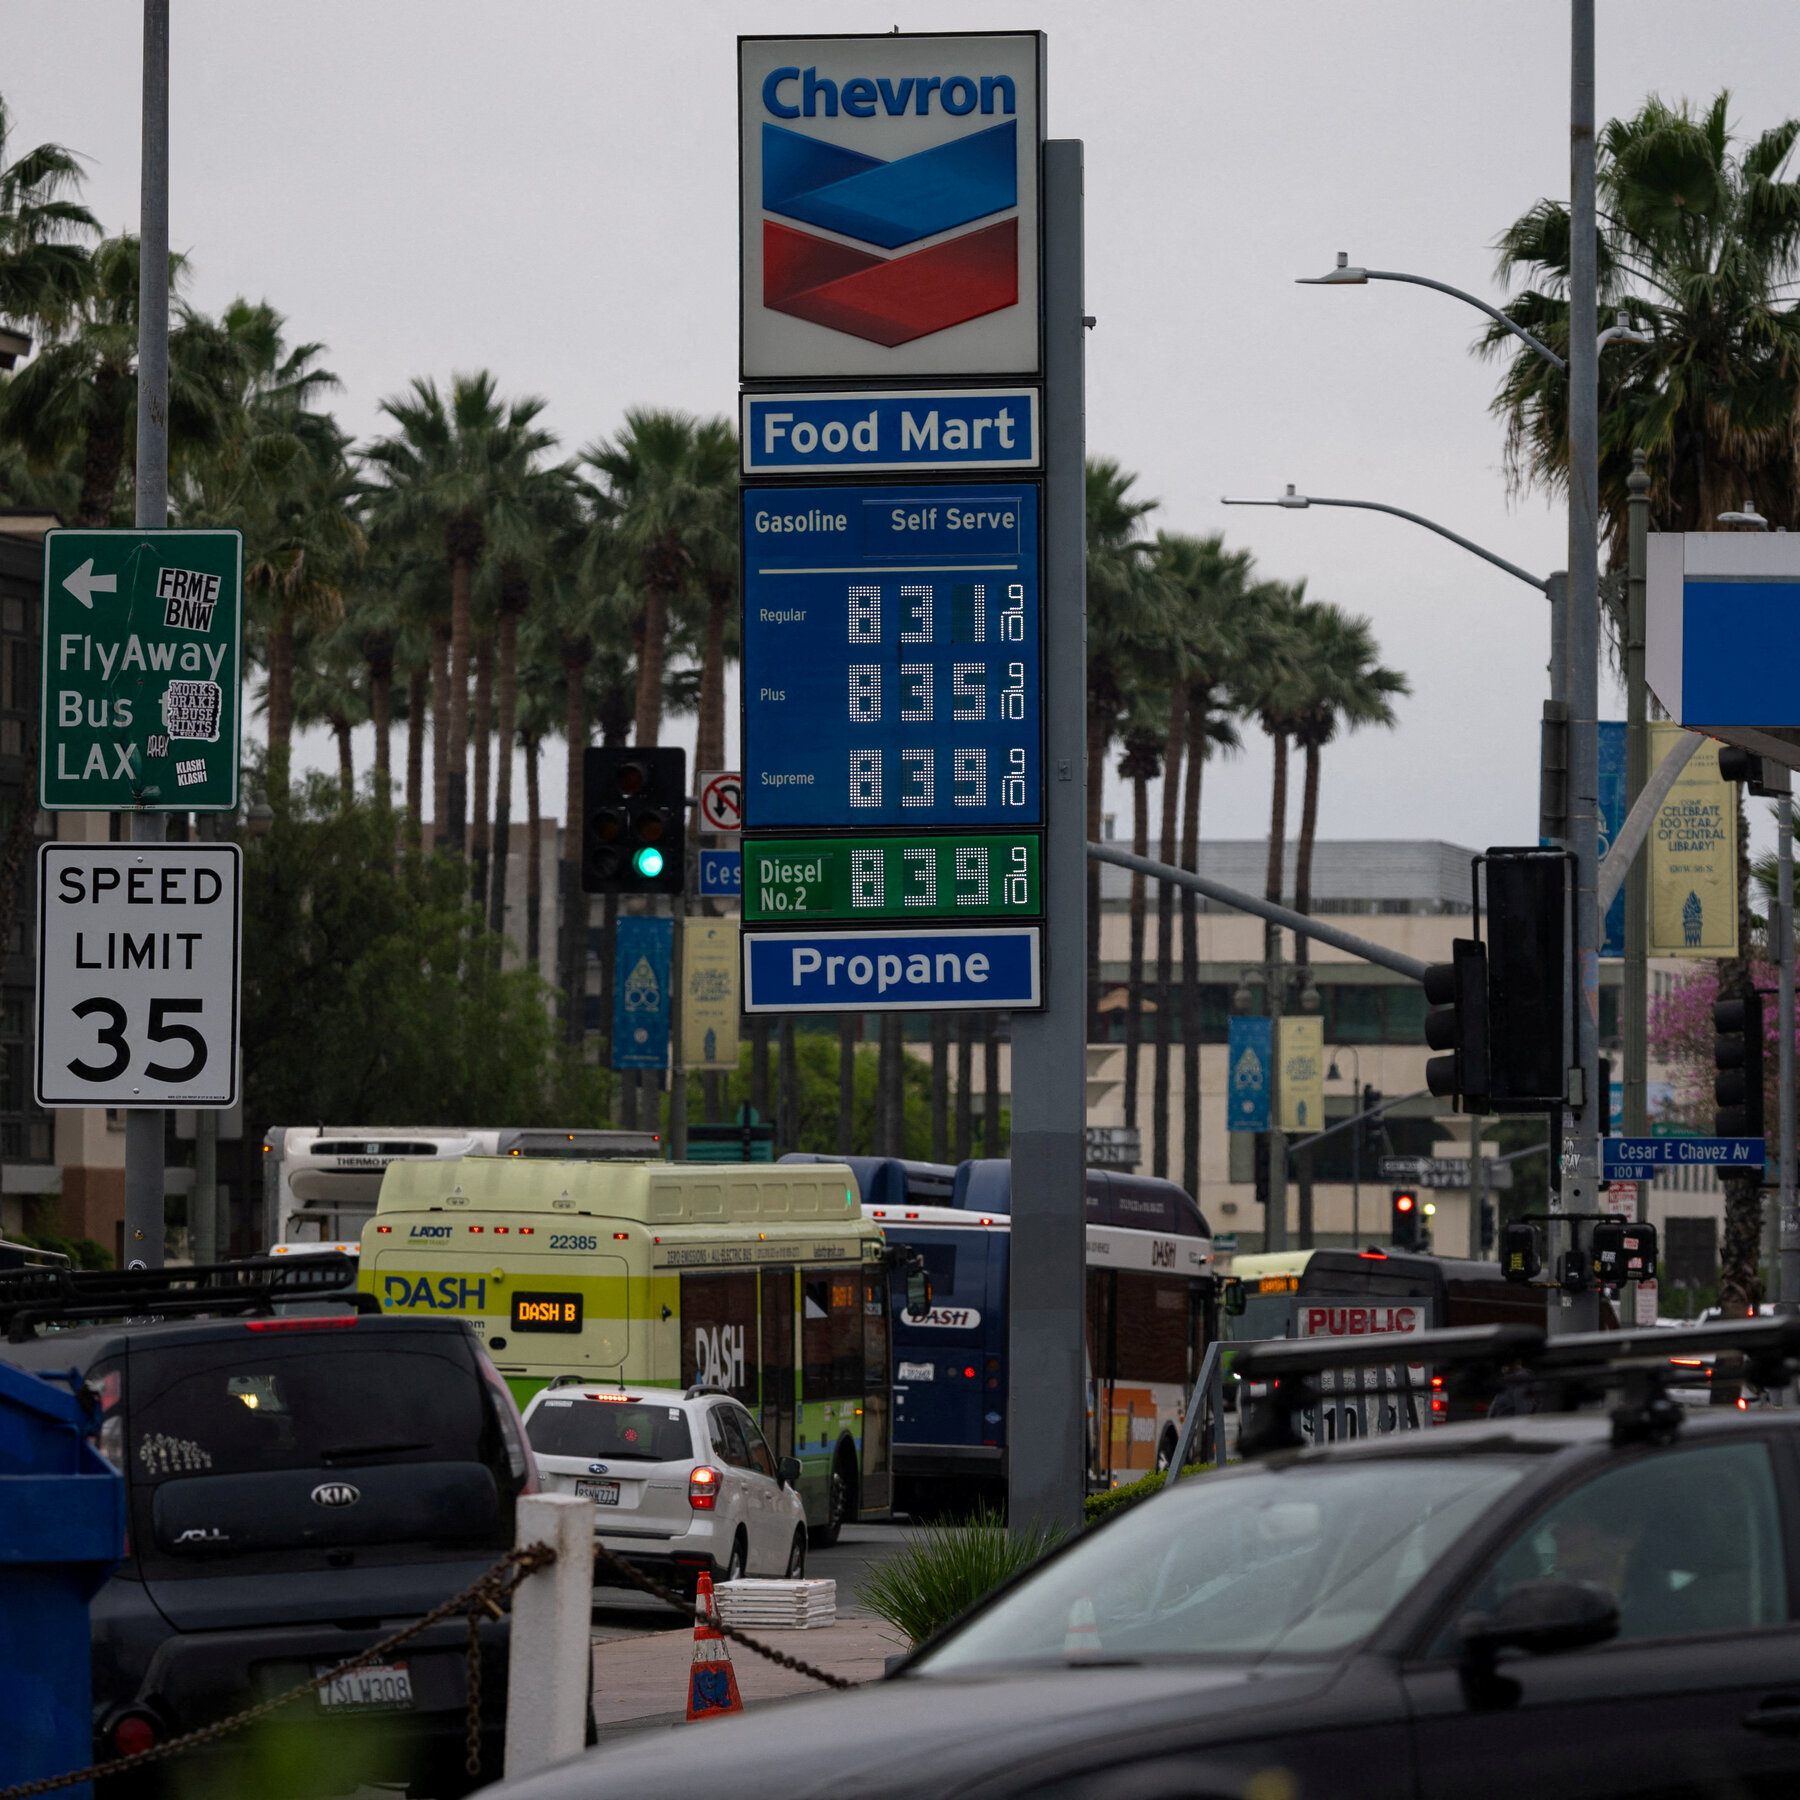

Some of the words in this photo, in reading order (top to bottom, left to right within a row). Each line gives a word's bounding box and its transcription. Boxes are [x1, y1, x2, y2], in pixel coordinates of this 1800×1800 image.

[762, 66, 1016, 118] Chevron
[764, 410, 878, 453] Food
[901, 408, 1015, 451] Mart
[755, 510, 847, 533] Gasoline
[891, 509, 937, 531] Self
[946, 508, 1015, 530] Serve
[159, 569, 218, 603] FRME
[166, 598, 213, 630] BNW
[760, 608, 806, 624] Regular
[60, 634, 227, 681] FlyAway
[170, 696, 215, 708] DRAKE
[760, 688, 785, 701] Plus
[59, 690, 133, 727] Bus
[171, 708, 213, 720] ABUSE
[171, 720, 213, 733] HINTS
[57, 743, 137, 780] LAX
[176, 758, 206, 774] KLASH1
[177, 771, 208, 787] KLASH1
[761, 772, 814, 787] Supreme
[1663, 806, 1720, 816] CELEBRATE
[1660, 817, 1681, 828] 100
[1684, 817, 1723, 828] YEARS
[1658, 829, 1673, 840] OF
[1677, 829, 1726, 840] CENTRAL
[1669, 841, 1715, 851] LIBRARY!
[760, 860, 822, 883] Diesel
[58, 867, 222, 904] SPEED
[761, 887, 807, 911] No.2
[76, 932, 202, 969] LIMIT
[792, 948, 990, 993] Propane
[66, 997, 208, 1083] 35
[1619, 1143, 1657, 1159] Cesar
[1664, 1143, 1673, 1159] E
[1679, 1143, 1728, 1159] Chavez
[1733, 1143, 1750, 1159] Av
[336, 1157, 380, 1166] THERMO
[1613, 1166, 1632, 1178] 100
[1634, 1166, 1644, 1178] W
[409, 1226, 453, 1238] LADOT
[550, 1236, 597, 1250] 22385
[384, 1276, 485, 1309] DASH
[519, 1303, 561, 1321] DASH
[565, 1304, 575, 1322] B
[1308, 1308, 1416, 1335] PUBLIC
[696, 1325, 745, 1389] DASH
[320, 1488, 353, 1504] KIA
